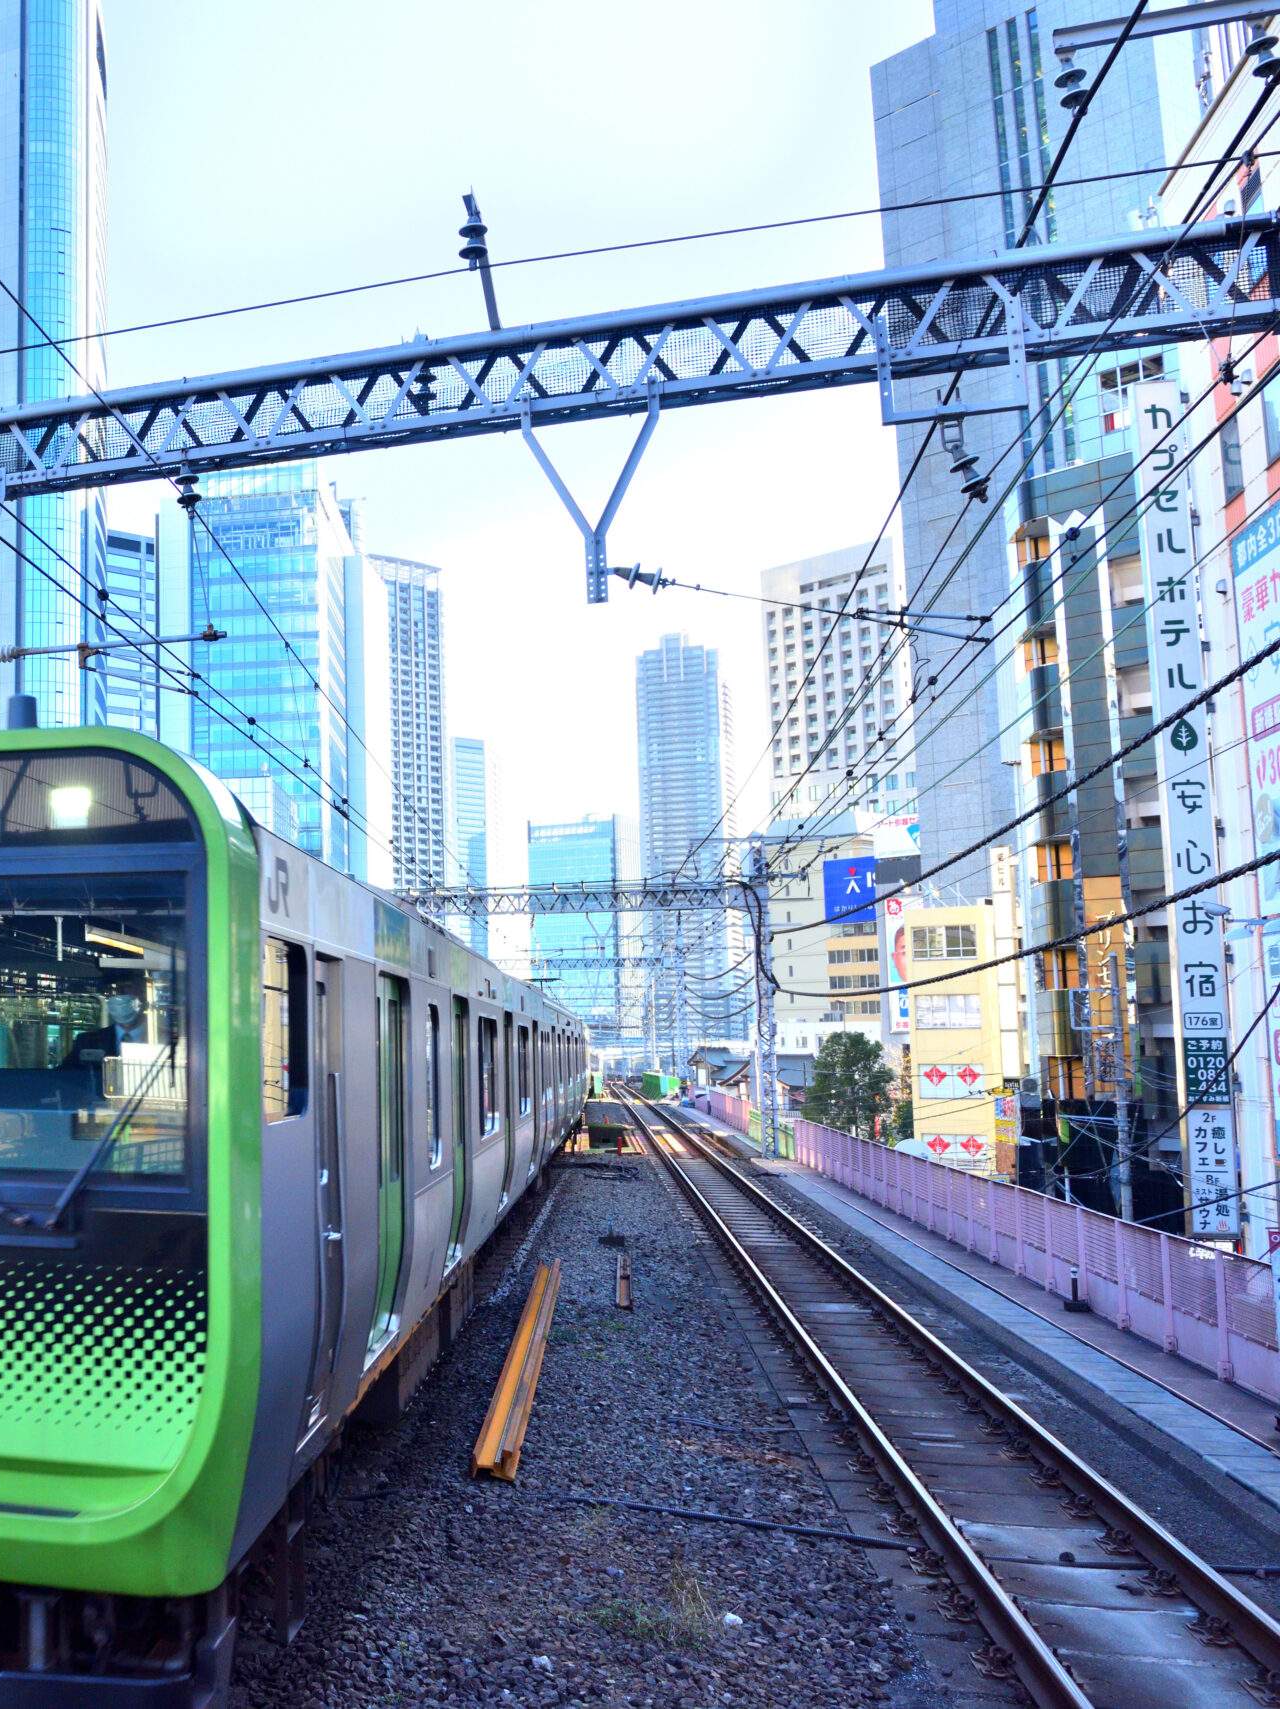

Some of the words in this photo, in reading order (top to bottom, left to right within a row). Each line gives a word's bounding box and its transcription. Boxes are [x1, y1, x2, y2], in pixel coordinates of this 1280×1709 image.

[1144, 404, 1196, 689] カプセルホテル
[1172, 779, 1219, 997] 安心お宿
[267, 855, 290, 918] JR
[1188, 1016, 1218, 1026] 176室
[1187, 1040, 1223, 1050] ご予約
[1187, 1056, 1225, 1068] 0120
[1202, 1112, 1217, 1123] 2F
[1194, 1126, 1210, 1167] カフェ
[1211, 1126, 1226, 1155] 癒し
[1198, 1196, 1211, 1230] サウナ
